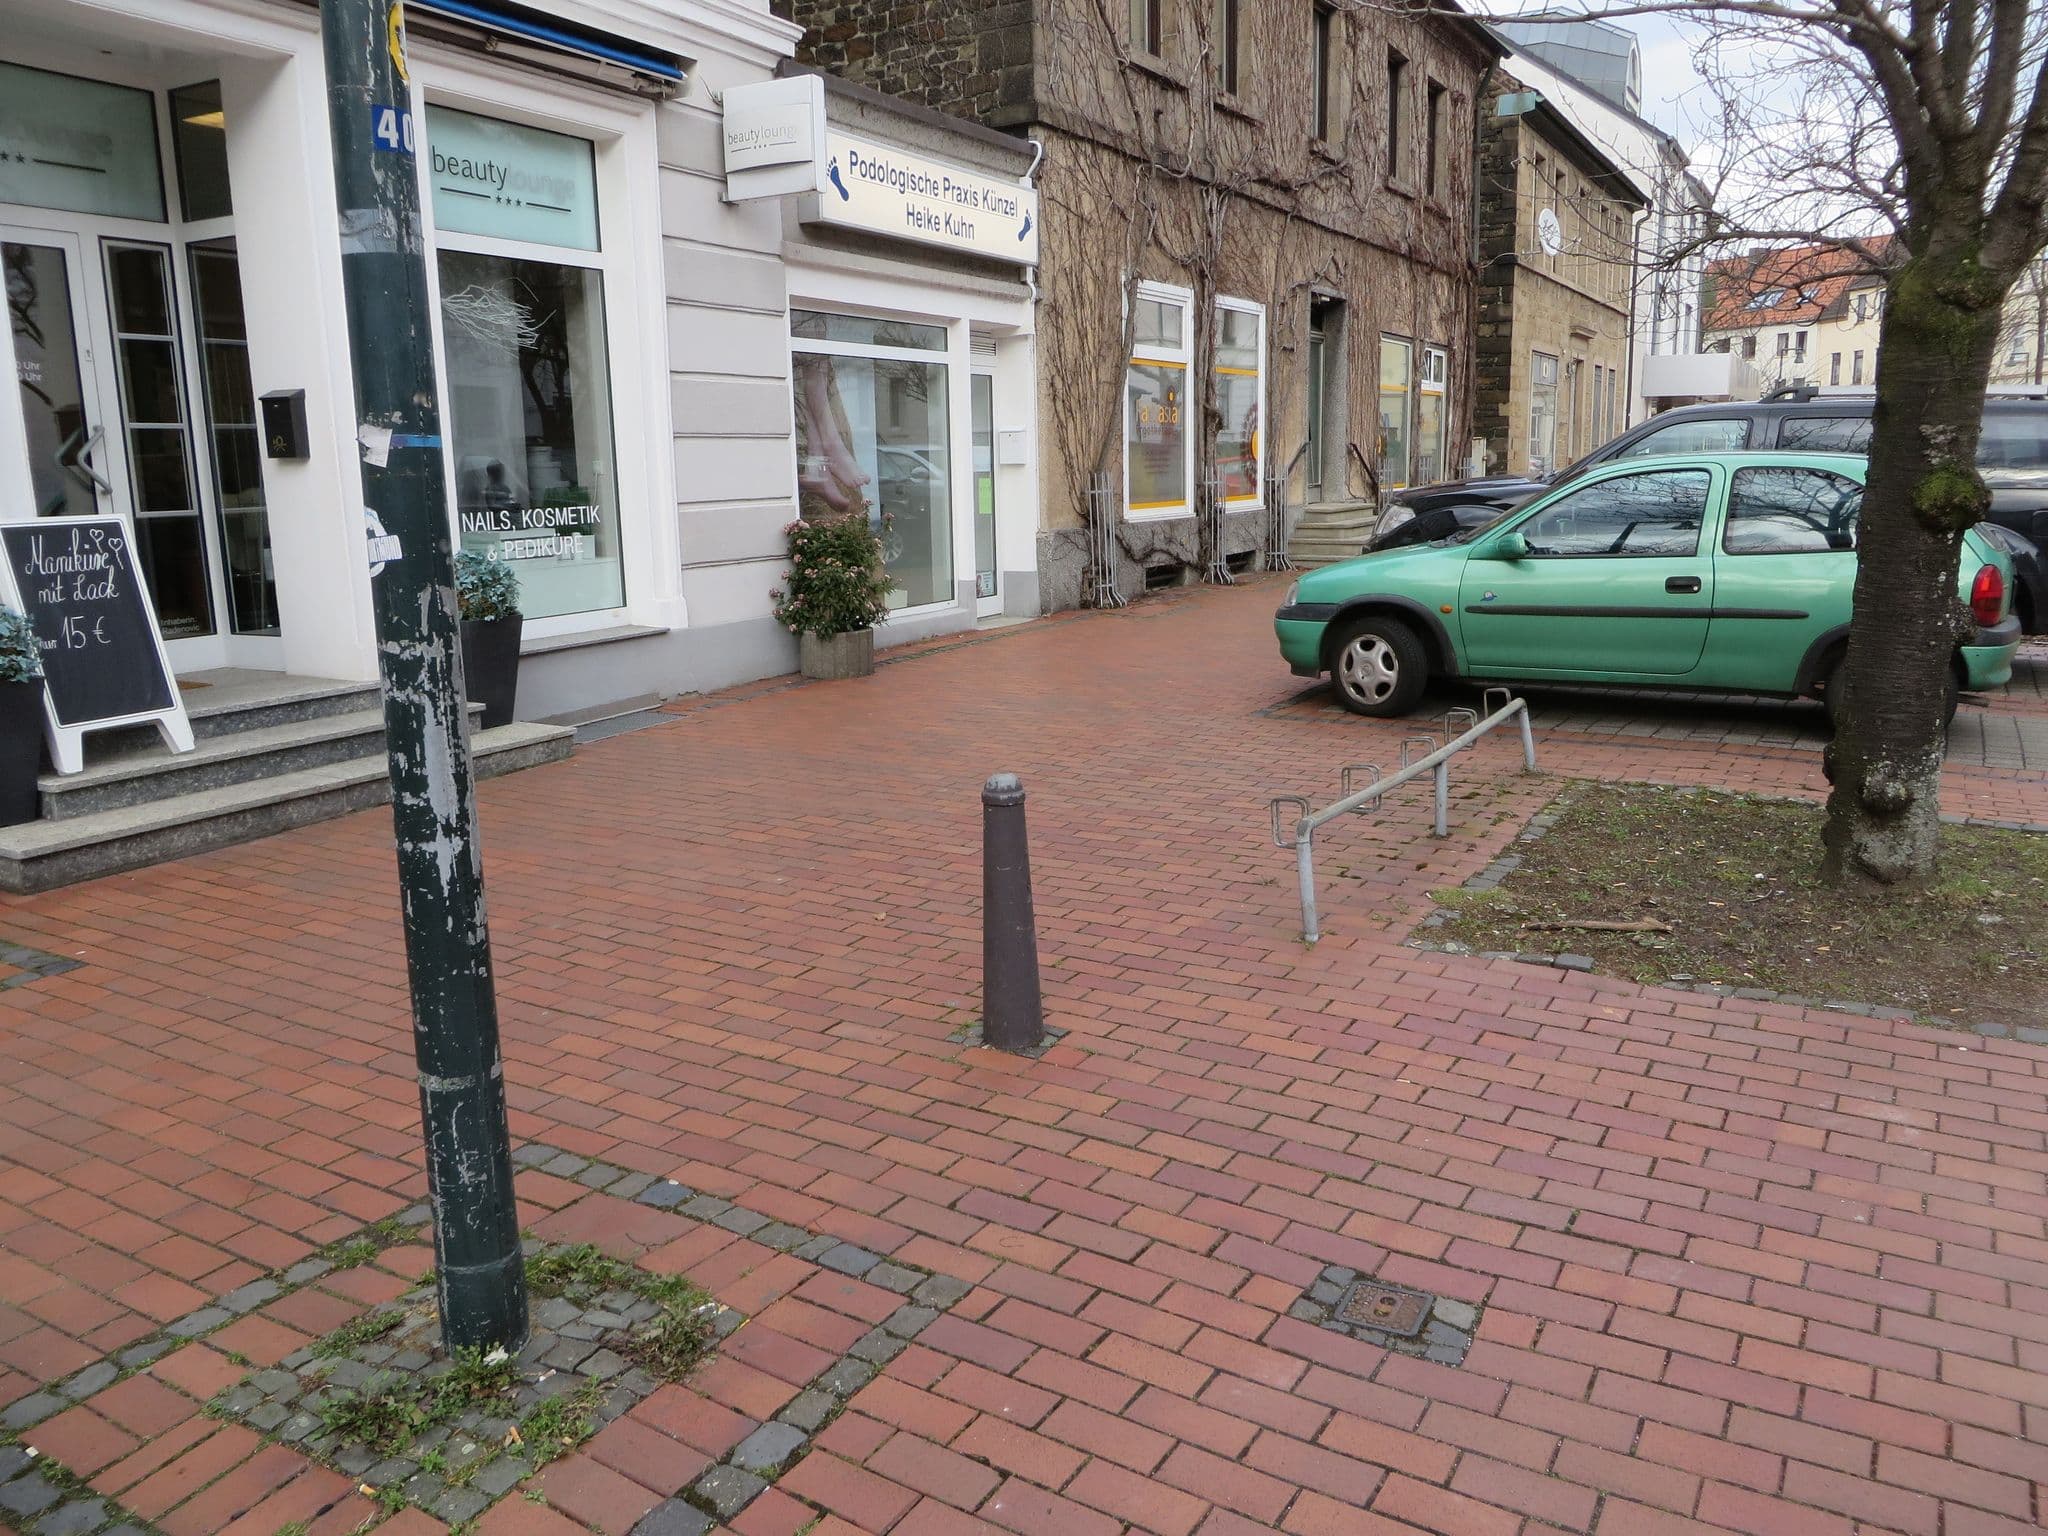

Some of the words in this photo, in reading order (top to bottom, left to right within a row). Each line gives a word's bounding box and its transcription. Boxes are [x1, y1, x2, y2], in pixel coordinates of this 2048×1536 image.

[377, 109, 415, 152] 40
[850, 150, 939, 198] Podologische
[943, 176, 979, 208] Praxis
[982, 189, 1018, 218] Künzel
[906, 202, 941, 233] Heike
[944, 212, 975, 240] Kuhn
[462, 510, 516, 533] NAILS,
[523, 505, 601, 528] KOSMETIK
[487, 545, 498, 562] &
[504, 535, 584, 560] PEDIKÜRE
[39, 575, 66, 604] mit
[73, 565, 119, 600] Lack
[61, 615, 87, 649] 15
[91, 616, 111, 644] €
